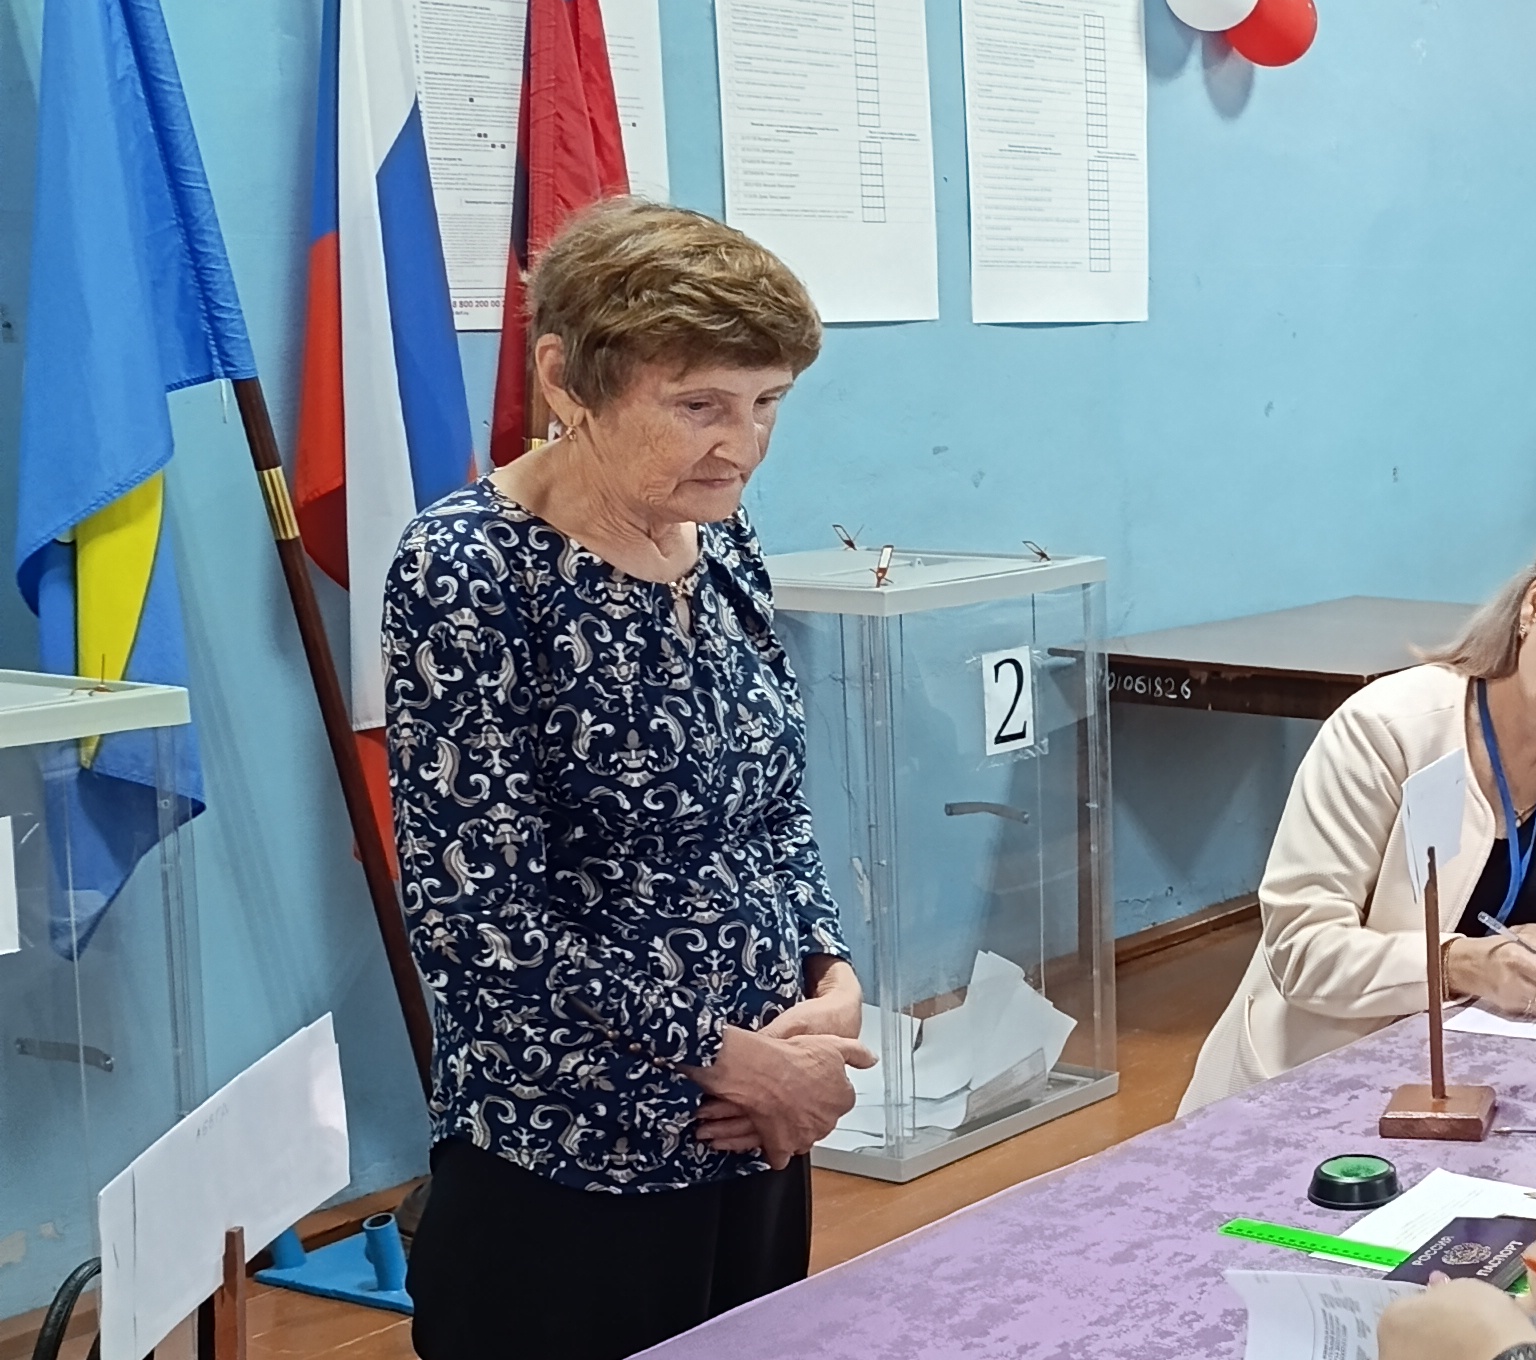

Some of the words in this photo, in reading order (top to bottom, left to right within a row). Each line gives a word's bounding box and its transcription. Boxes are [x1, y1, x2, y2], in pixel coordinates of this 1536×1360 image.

[994, 658, 1027, 745] 2
[1411, 1235, 1455, 1266] РОССИЯ
[1476, 1240, 1524, 1277] ПАСПОРТ
